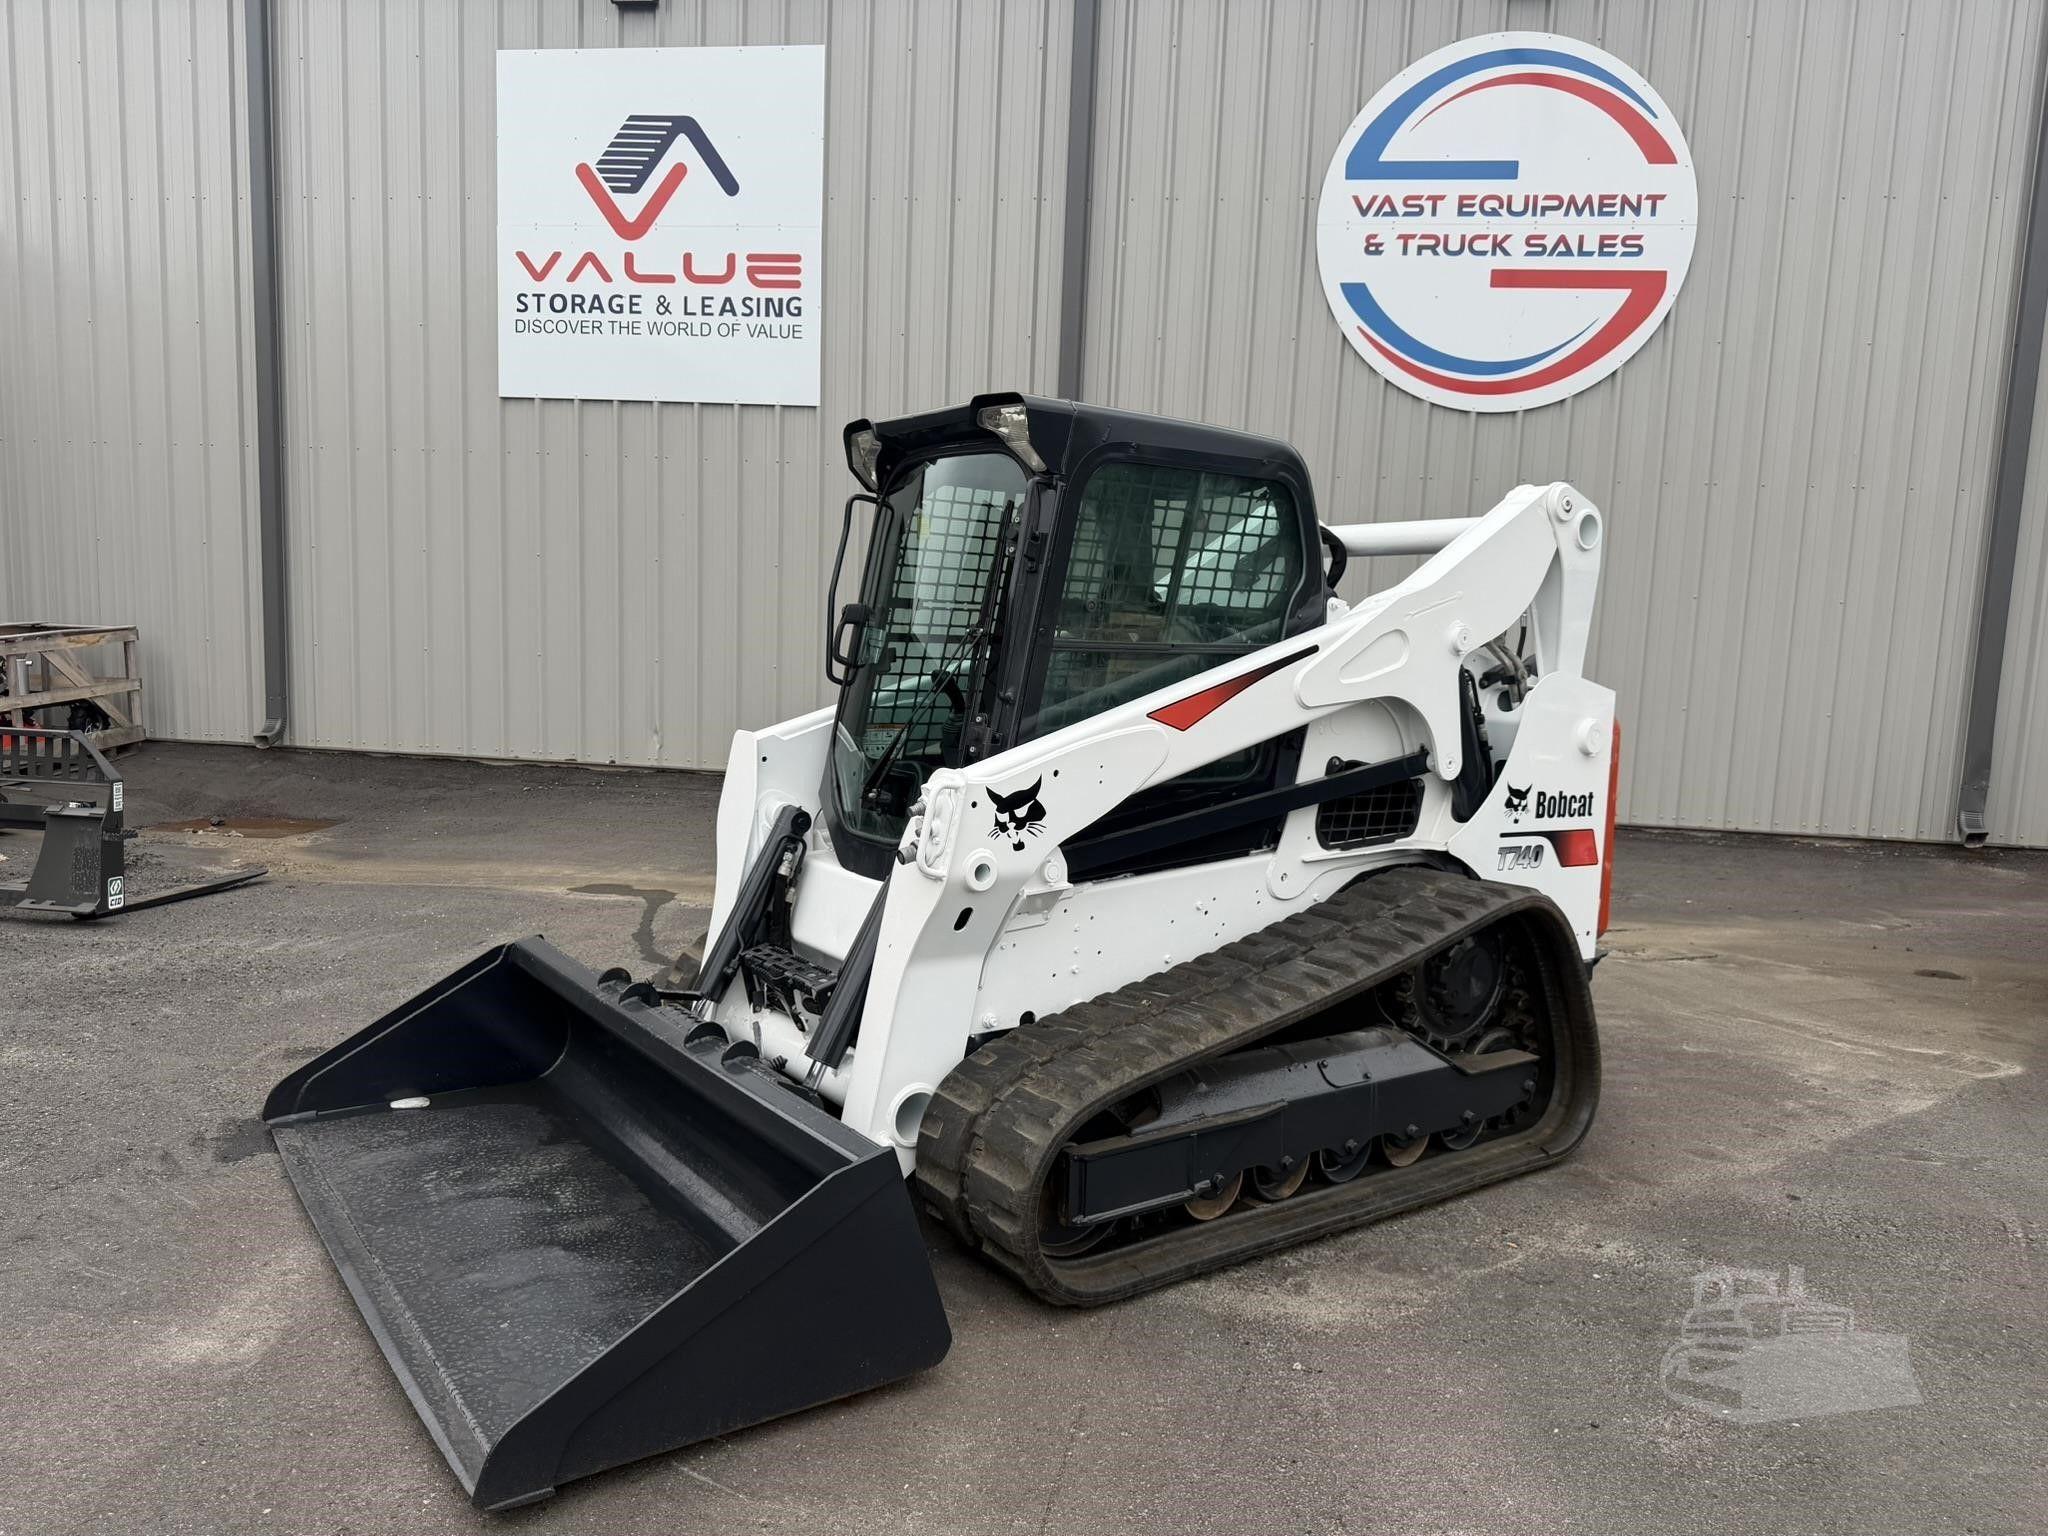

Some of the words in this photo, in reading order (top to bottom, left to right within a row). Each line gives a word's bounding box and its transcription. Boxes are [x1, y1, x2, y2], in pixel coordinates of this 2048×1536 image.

[1352, 194, 1447, 217] VAST
[1456, 194, 1667, 217] EQUIPMENT
[1363, 233, 1385, 256] &
[1396, 233, 1513, 257] TRUCK
[1523, 234, 1644, 257] SALES
[515, 250, 802, 289] VALUE
[516, 292, 643, 315] STORAGE
[655, 294, 673, 315] &
[683, 296, 803, 318] LEASING
[514, 318, 604, 335] DISCOVER
[608, 320, 642, 336] THE
[647, 321, 712, 338] WORLD
[717, 322, 742, 338] OF
[745, 323, 803, 340] VALUE
[1535, 790, 1593, 819] Bobcat
[1497, 844, 1545, 872] T740
